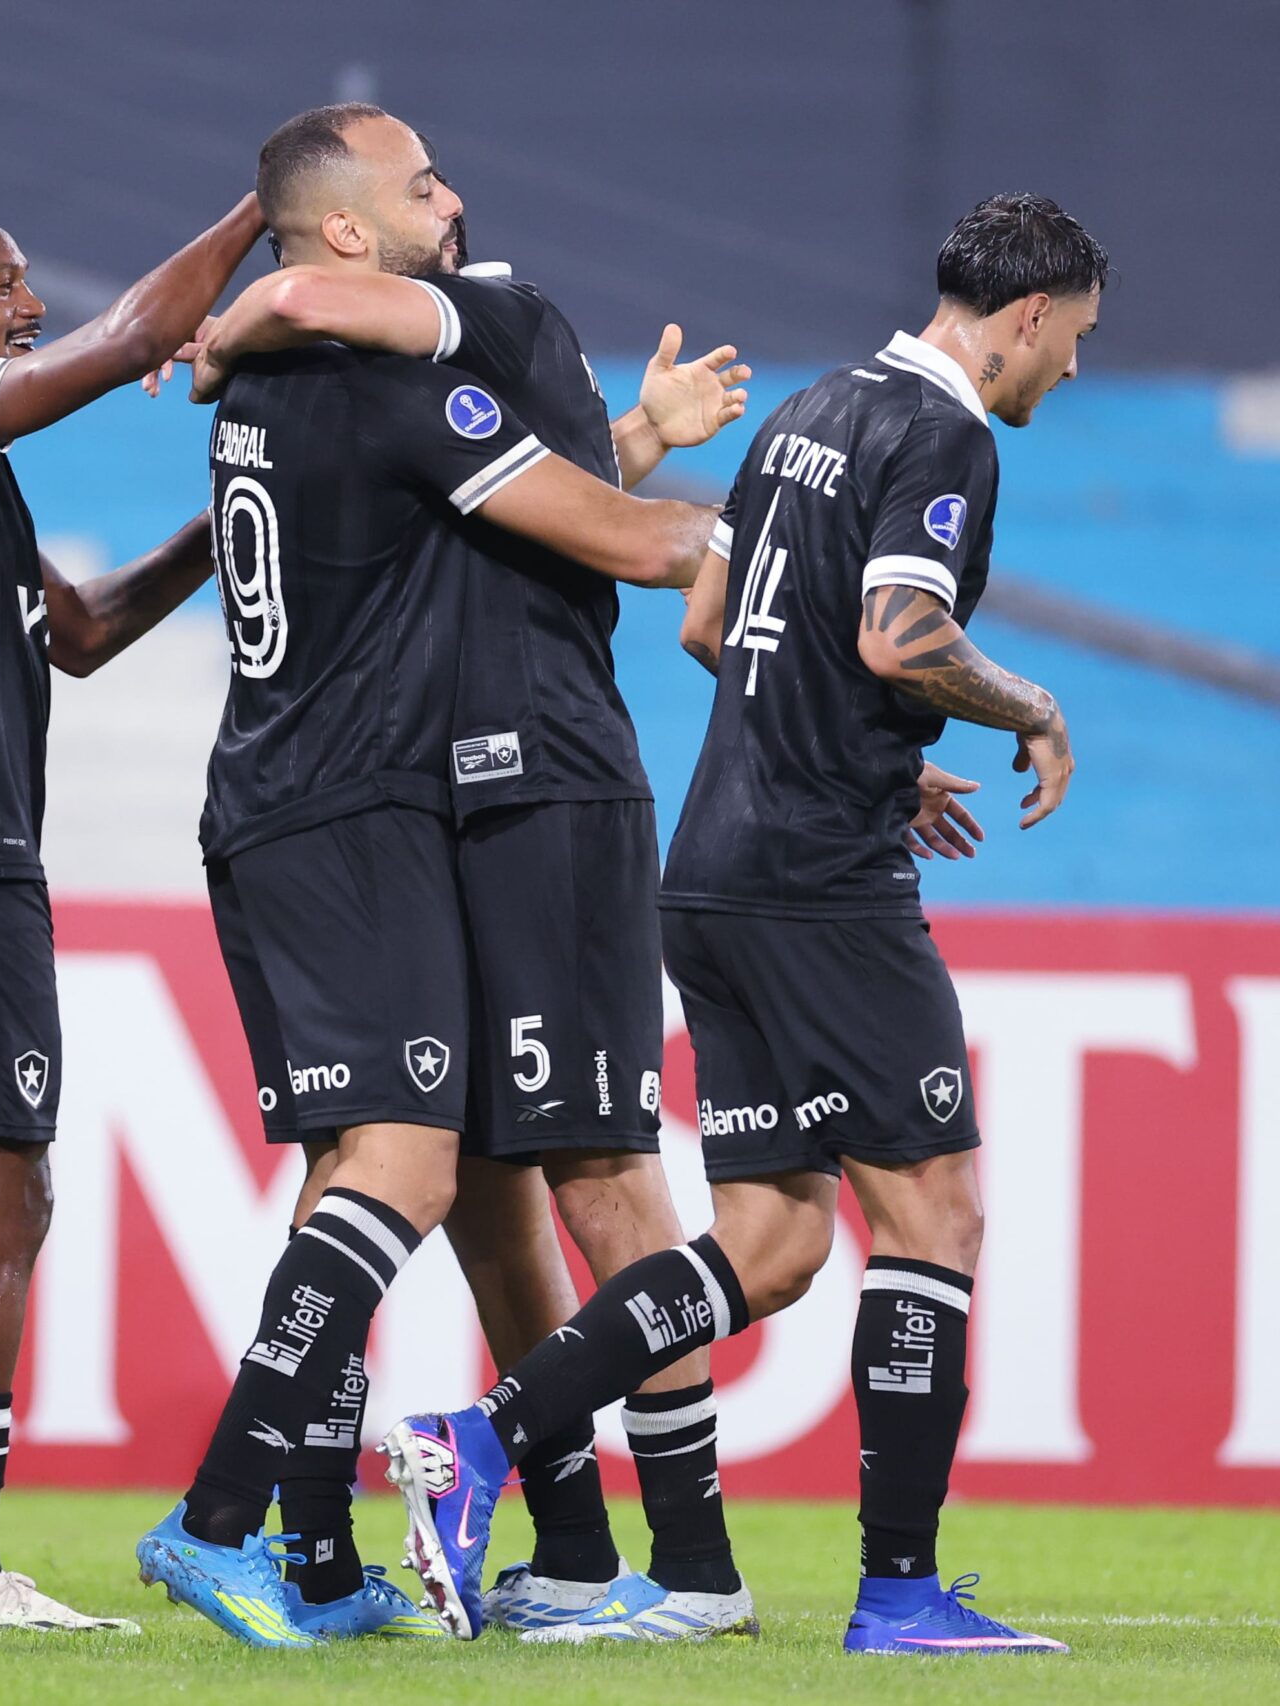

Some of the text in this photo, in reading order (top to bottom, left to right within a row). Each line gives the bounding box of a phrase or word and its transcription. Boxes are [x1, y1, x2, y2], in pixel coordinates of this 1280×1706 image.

[216, 421, 273, 470] CABRAL
[211, 474, 289, 680] 9
[724, 485, 789, 697] 4
[510, 1014, 551, 1093] 5
[594, 1050, 613, 1116] Reebok
[270, 1284, 336, 1359] Lifefit
